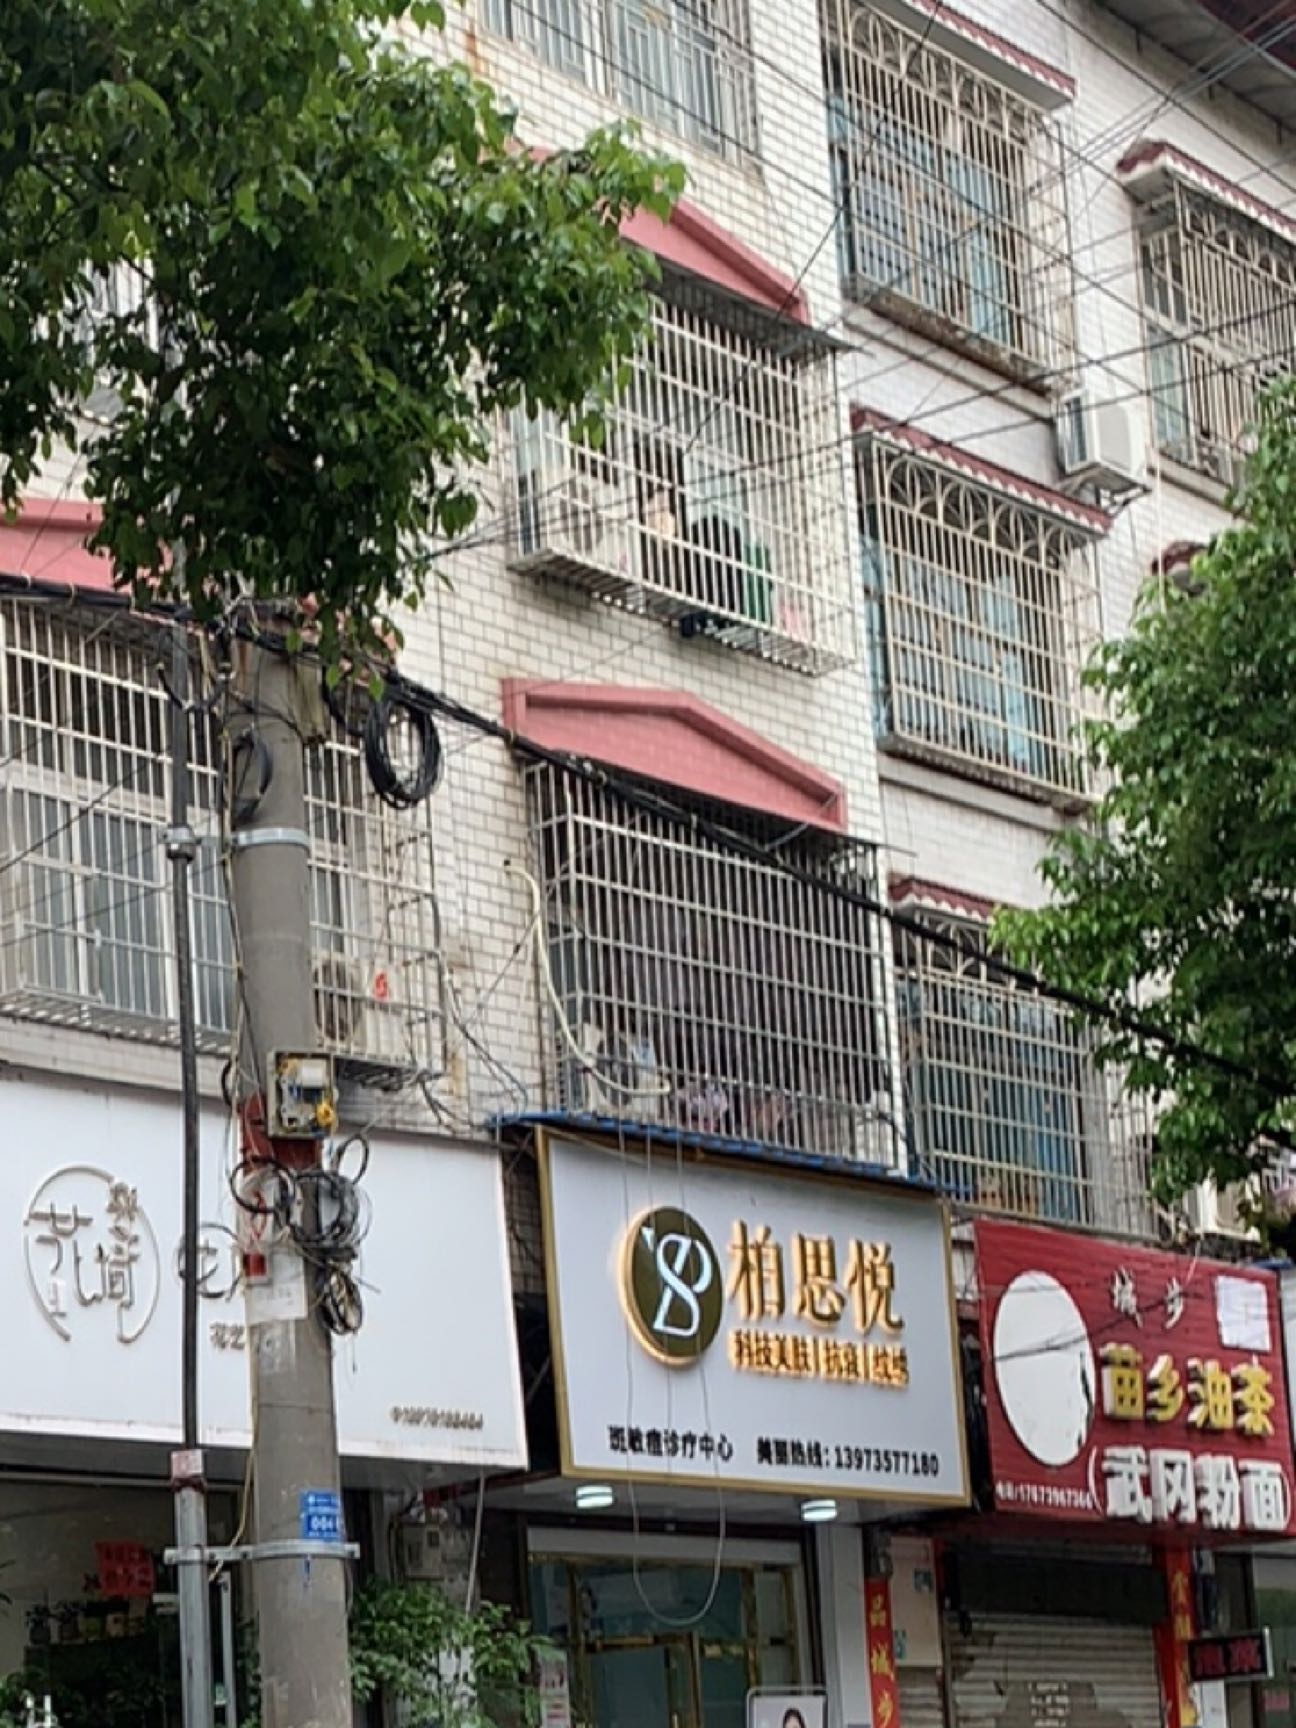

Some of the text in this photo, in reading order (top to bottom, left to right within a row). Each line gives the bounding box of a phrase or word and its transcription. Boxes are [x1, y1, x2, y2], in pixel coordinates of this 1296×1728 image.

[726, 1217, 905, 1335] 柏思悦
[1100, 1342, 1275, 1437] 苗乡油茶
